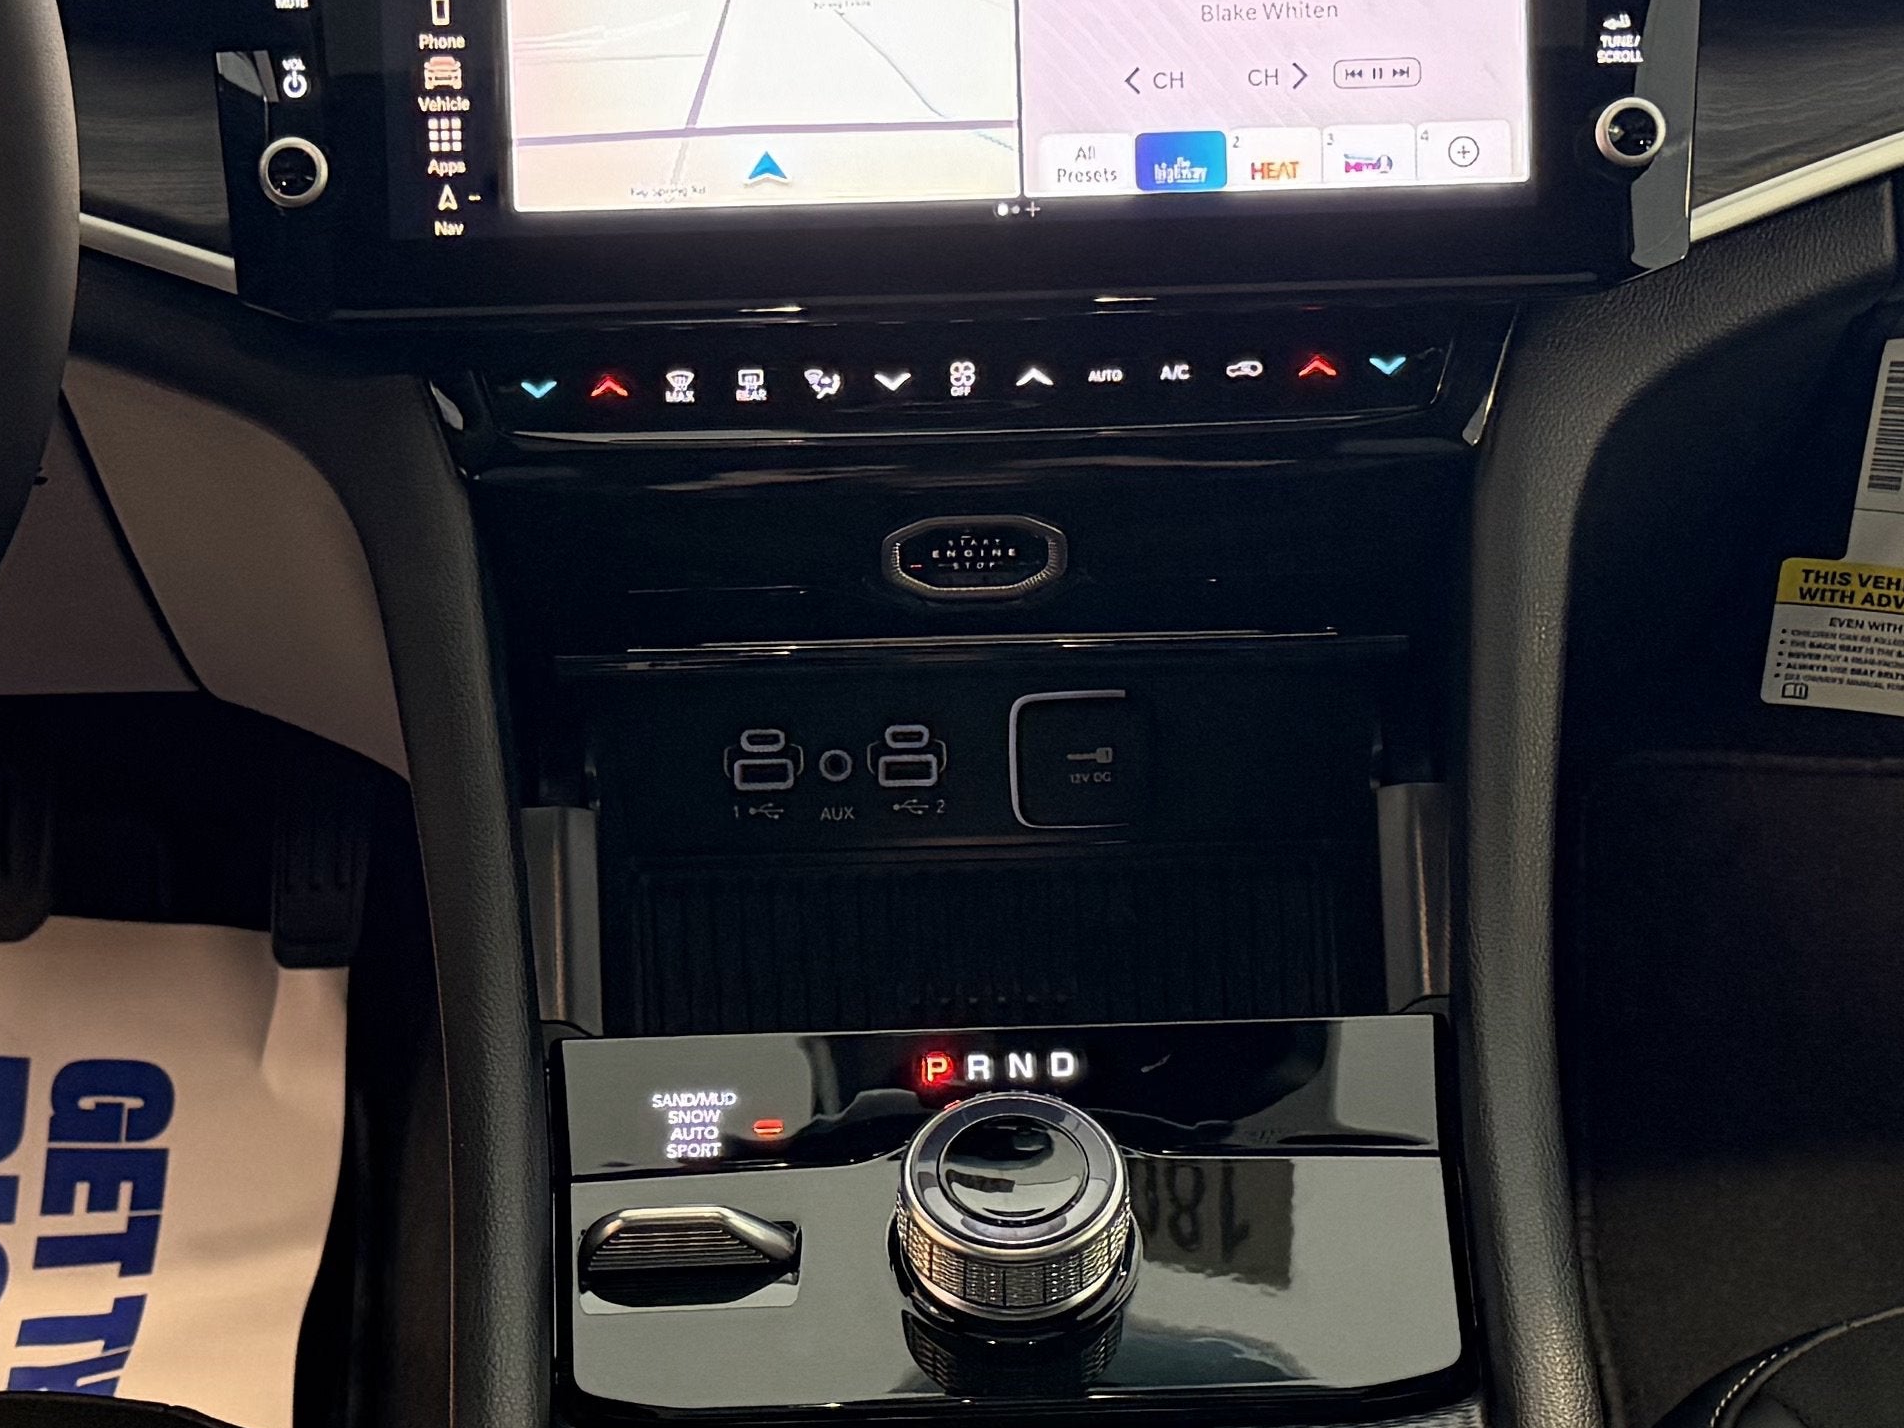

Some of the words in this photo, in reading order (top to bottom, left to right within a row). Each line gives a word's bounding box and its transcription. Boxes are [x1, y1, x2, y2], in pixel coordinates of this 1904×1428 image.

[1200, 2, 1257, 22] Blake
[1261, 1, 1339, 20] Whiten
[418, 33, 465, 51] Phone
[282, 58, 306, 71] VOL
[1597, 49, 1644, 64] SCROLL
[1152, 71, 1184, 90] CH
[1247, 68, 1280, 87] CH
[418, 95, 469, 113] Vehicle
[1232, 136, 1240, 148] 2
[1326, 133, 1334, 145] 3
[1075, 145, 1097, 161] All
[427, 158, 466, 177] Apps
[1056, 167, 1118, 184] Presets
[1250, 161, 1300, 181] HEAT
[434, 221, 463, 237] Nav
[1088, 369, 1123, 383] AUTO
[1160, 364, 1190, 381] A/C
[950, 385, 971, 397] OFF
[947, 538, 1000, 547] START
[932, 548, 1017, 559] ENGINE
[1801, 568, 1852, 586] THIS
[1798, 586, 1856, 605] WITH
[1829, 617, 1865, 630] EVEN
[1867, 619, 1903, 635] WITH
[820, 805, 856, 821] AUX
[926, 1056, 949, 1083] P
[967, 1053, 990, 1081] R
[1007, 1052, 1033, 1079] N
[1050, 1051, 1075, 1077] D
[651, 1091, 738, 1109] SAND/MUD
[667, 1109, 722, 1125] SNOW
[670, 1126, 720, 1141] AUTO
[666, 1142, 722, 1159] SPORT
[33, 1058, 175, 1278] GET
